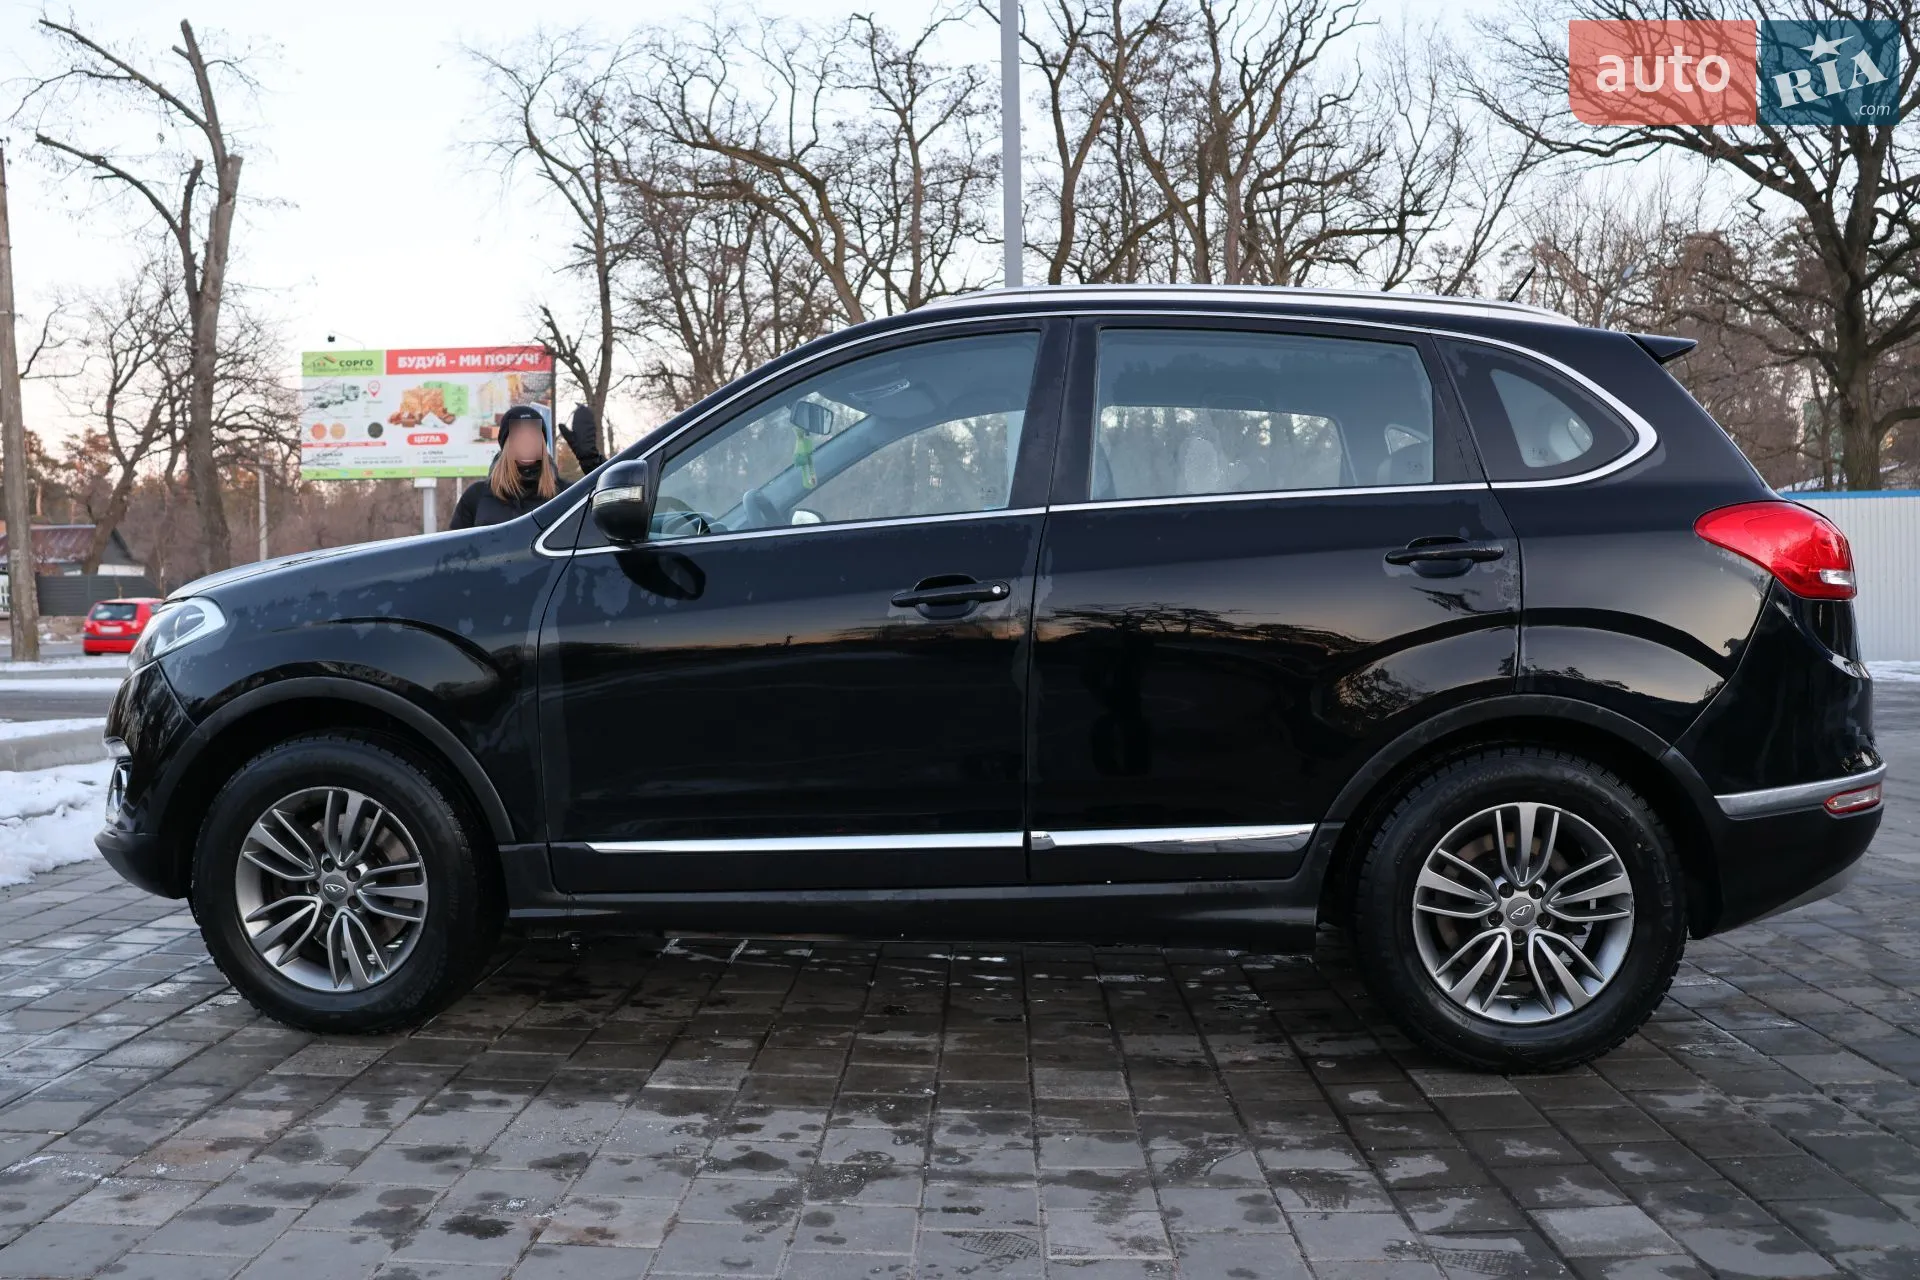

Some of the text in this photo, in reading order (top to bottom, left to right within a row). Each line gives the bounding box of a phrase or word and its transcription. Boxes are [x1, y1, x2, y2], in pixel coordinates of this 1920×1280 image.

[338, 359, 374, 367] СОРГО
[398, 353, 446, 369] БУДУЙ
[459, 354, 481, 367] МИ
[484, 353, 539, 366] ПОРУЧ!
[413, 435, 442, 444] ЦЕГЛА
